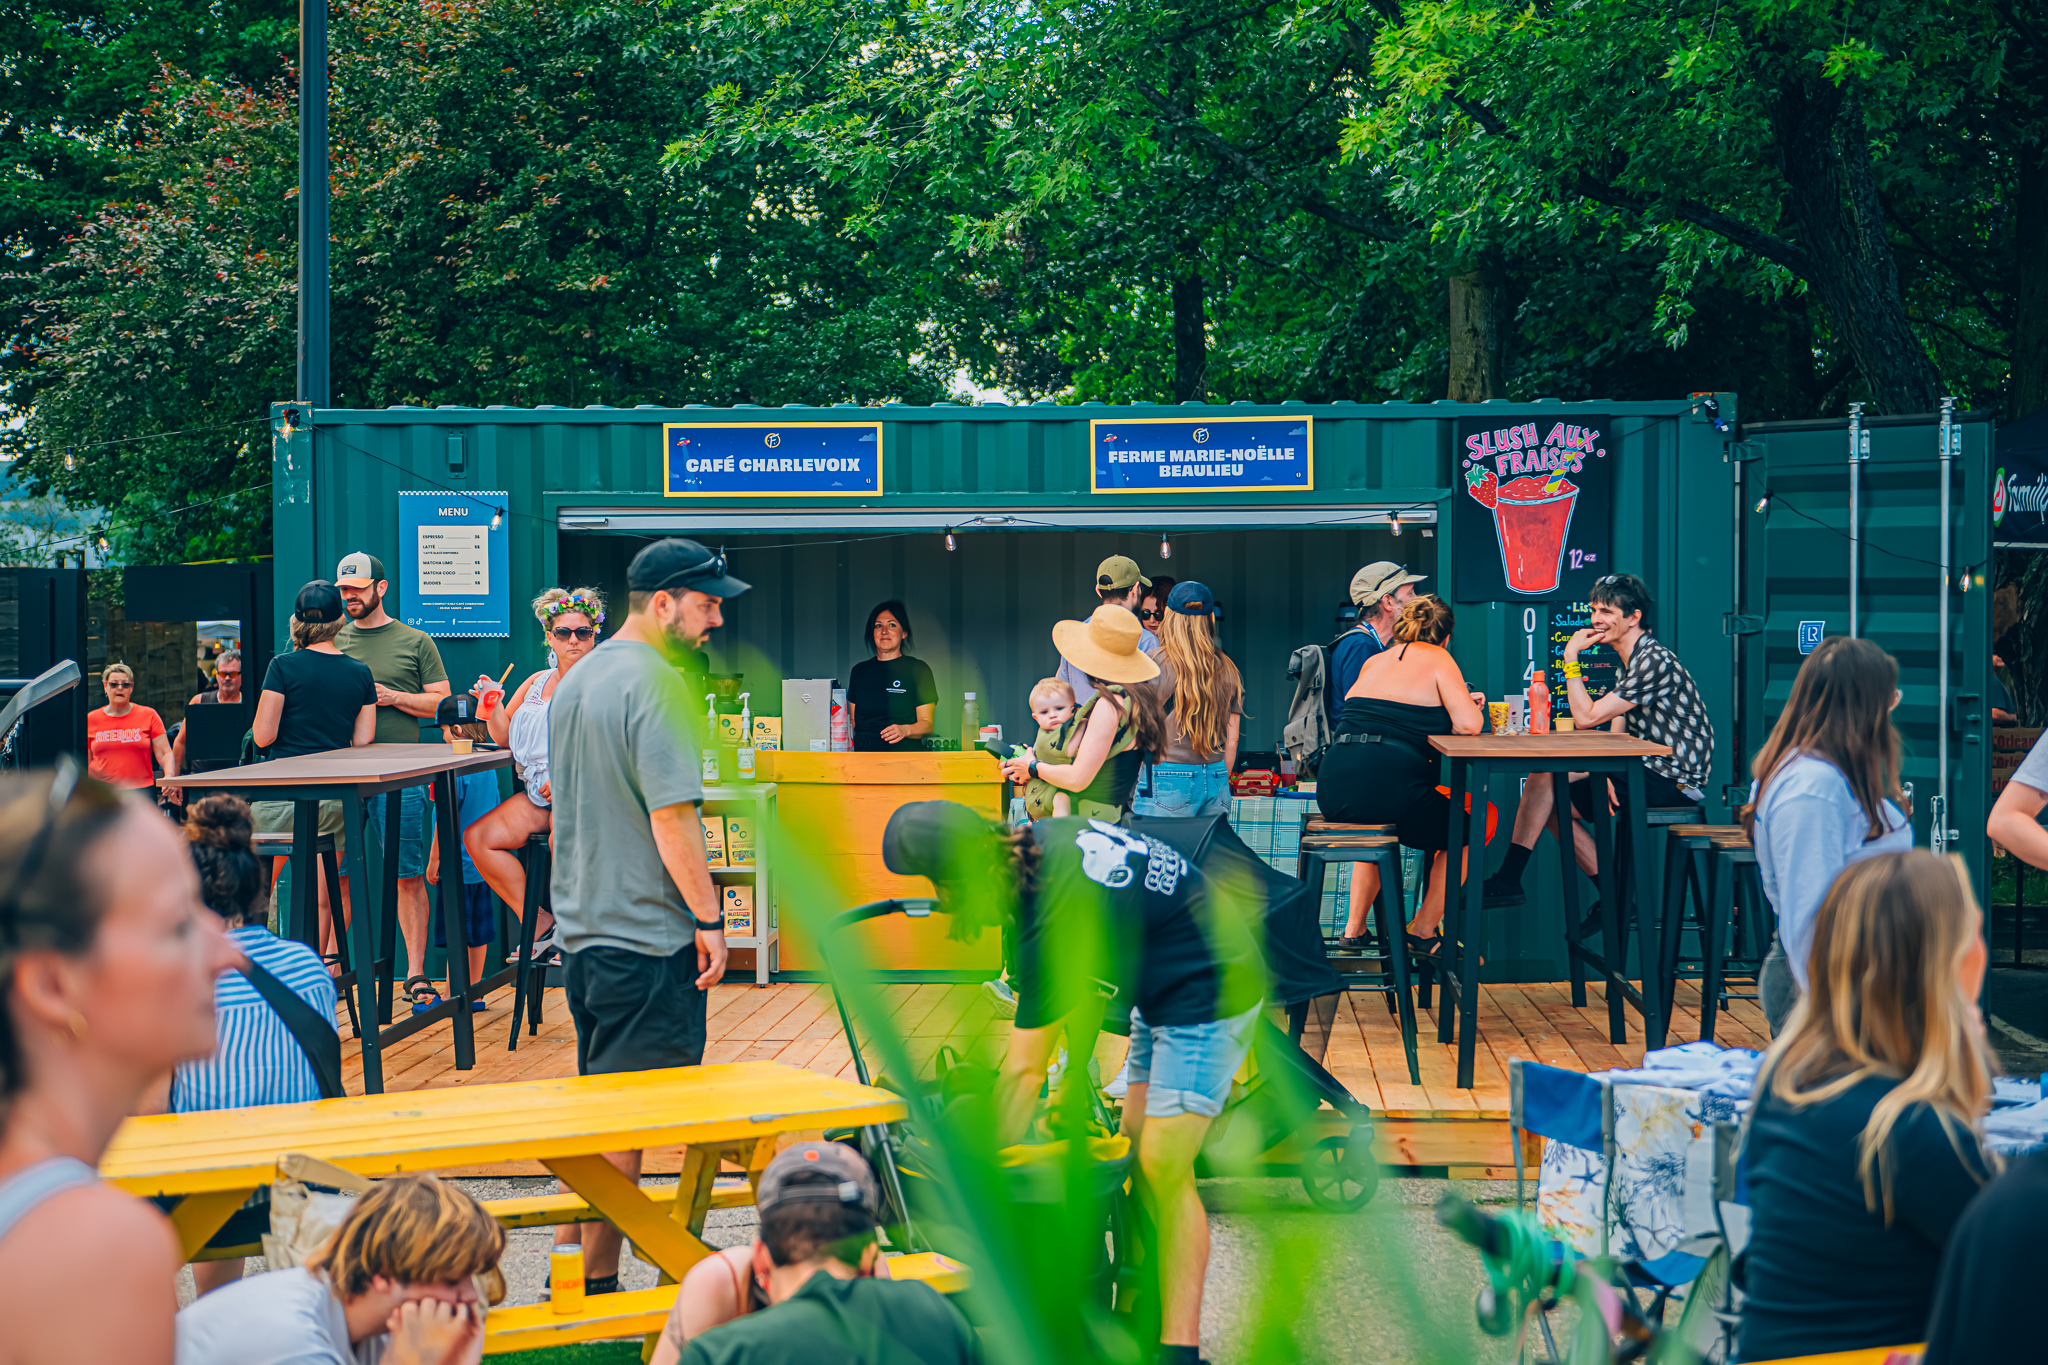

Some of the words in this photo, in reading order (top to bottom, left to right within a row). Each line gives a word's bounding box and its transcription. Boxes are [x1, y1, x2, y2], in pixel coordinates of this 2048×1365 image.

[1466, 422, 1539, 461] SLUSH
[1544, 421, 1600, 453] AUX
[686, 454, 735, 473] CAFÉ
[739, 457, 861, 472] CHARLEVOIX
[1109, 450, 1166, 464] FERME
[1169, 445, 1295, 463] MARIE-NOËLLE
[1159, 463, 1244, 477] BEAULIEU
[438, 507, 469, 517] MENU
[1568, 548, 1584, 571] 12
[1555, 614, 1585, 627] Salade
